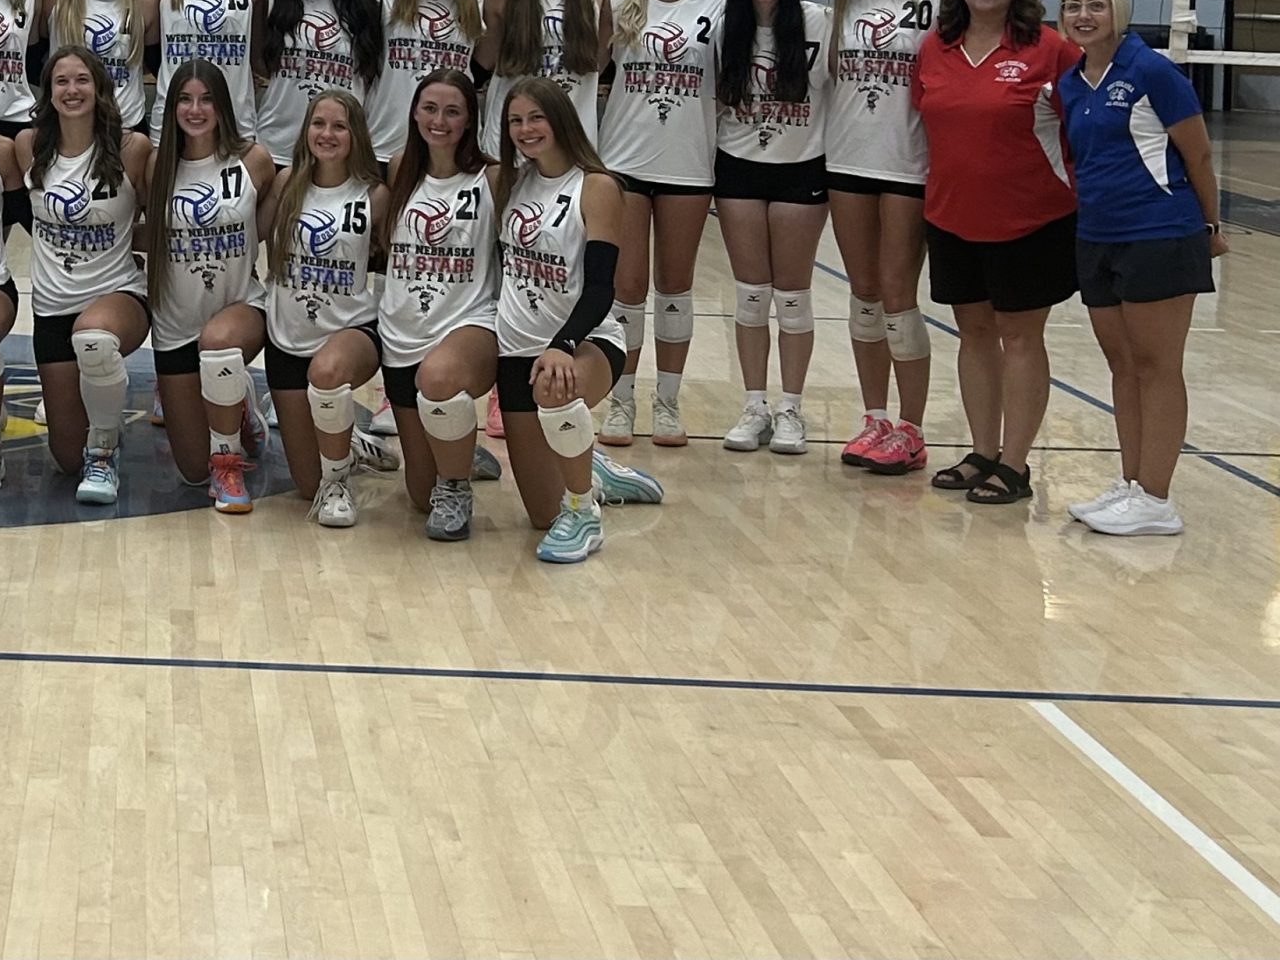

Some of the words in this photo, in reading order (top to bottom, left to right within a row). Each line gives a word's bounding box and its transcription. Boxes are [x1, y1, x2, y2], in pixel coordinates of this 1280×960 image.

[696, 15, 713, 44] 2
[900, 0, 933, 30] 20
[166, 34, 193, 44] WEST
[196, 34, 246, 44] NEBRASKA
[166, 43, 195, 57] ALL
[198, 43, 246, 58] STARS
[220, 165, 243, 200] 17
[341, 201, 367, 235] 15
[455, 187, 481, 220] 21
[552, 194, 572, 227] 7
[300, 256, 356, 271] NEBRASKA
[415, 245, 475, 257] NEBRASKA
[415, 256, 474, 274] STARS
